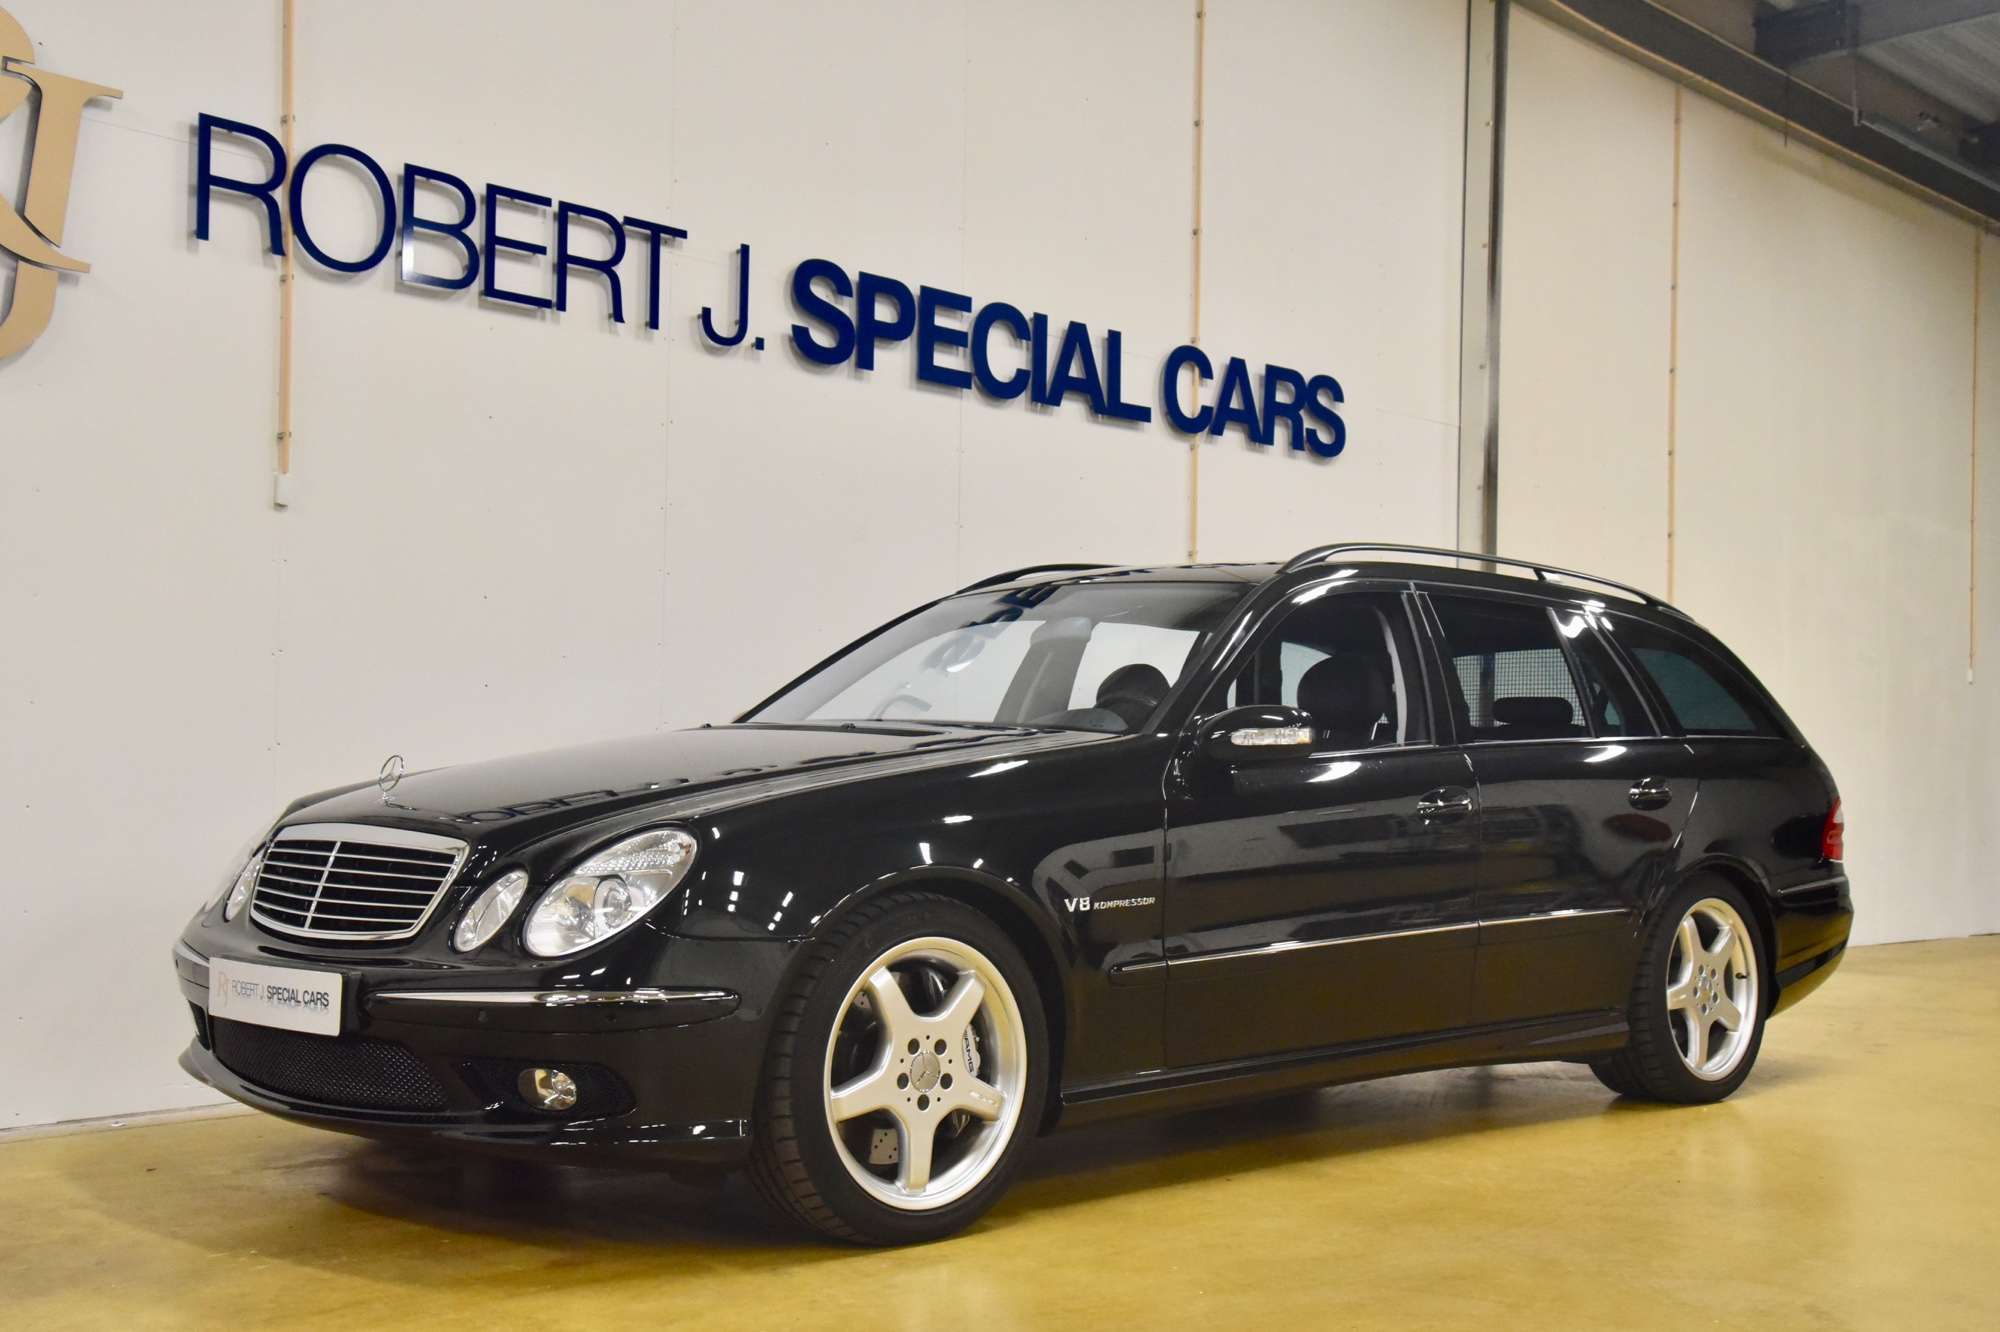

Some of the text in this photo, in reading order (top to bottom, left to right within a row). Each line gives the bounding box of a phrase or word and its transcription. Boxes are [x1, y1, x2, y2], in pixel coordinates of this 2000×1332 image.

[196, 112, 1346, 458] ROBERT J. SPECIAL CARS
[1064, 896, 1156, 912] V8 KOMPRESSOR
[266, 985, 302, 1003] SPECIAL
[303, 990, 330, 1007] CARS
